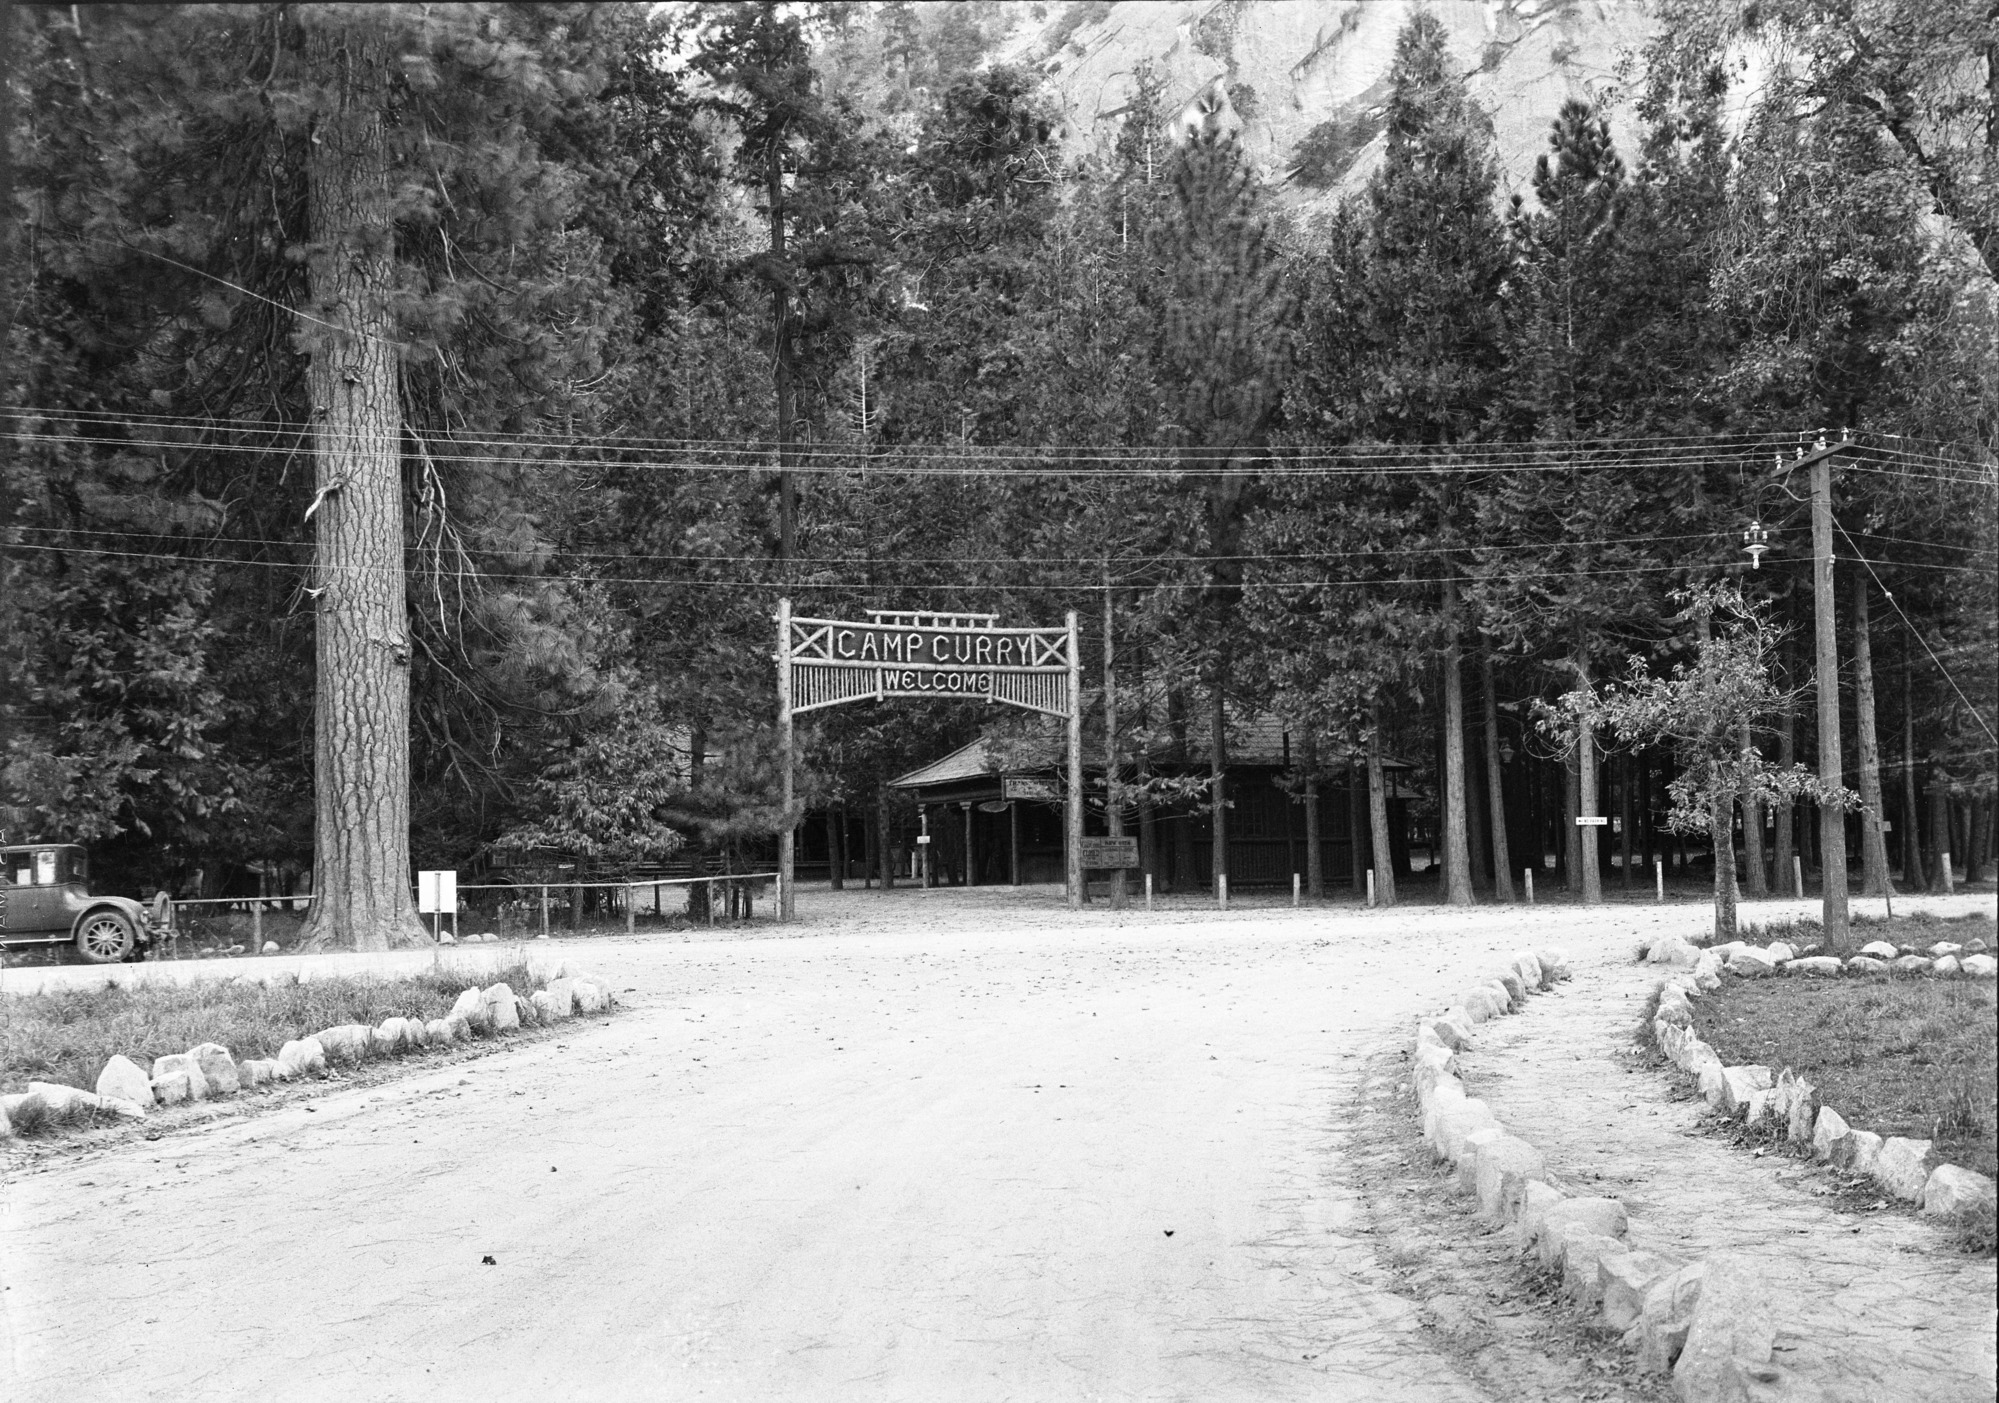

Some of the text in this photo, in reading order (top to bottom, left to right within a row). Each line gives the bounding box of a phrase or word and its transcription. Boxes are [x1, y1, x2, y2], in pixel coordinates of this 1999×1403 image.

[838, 629, 1030, 665] CAMP CURRY
[884, 669, 991, 692] WELCOME
